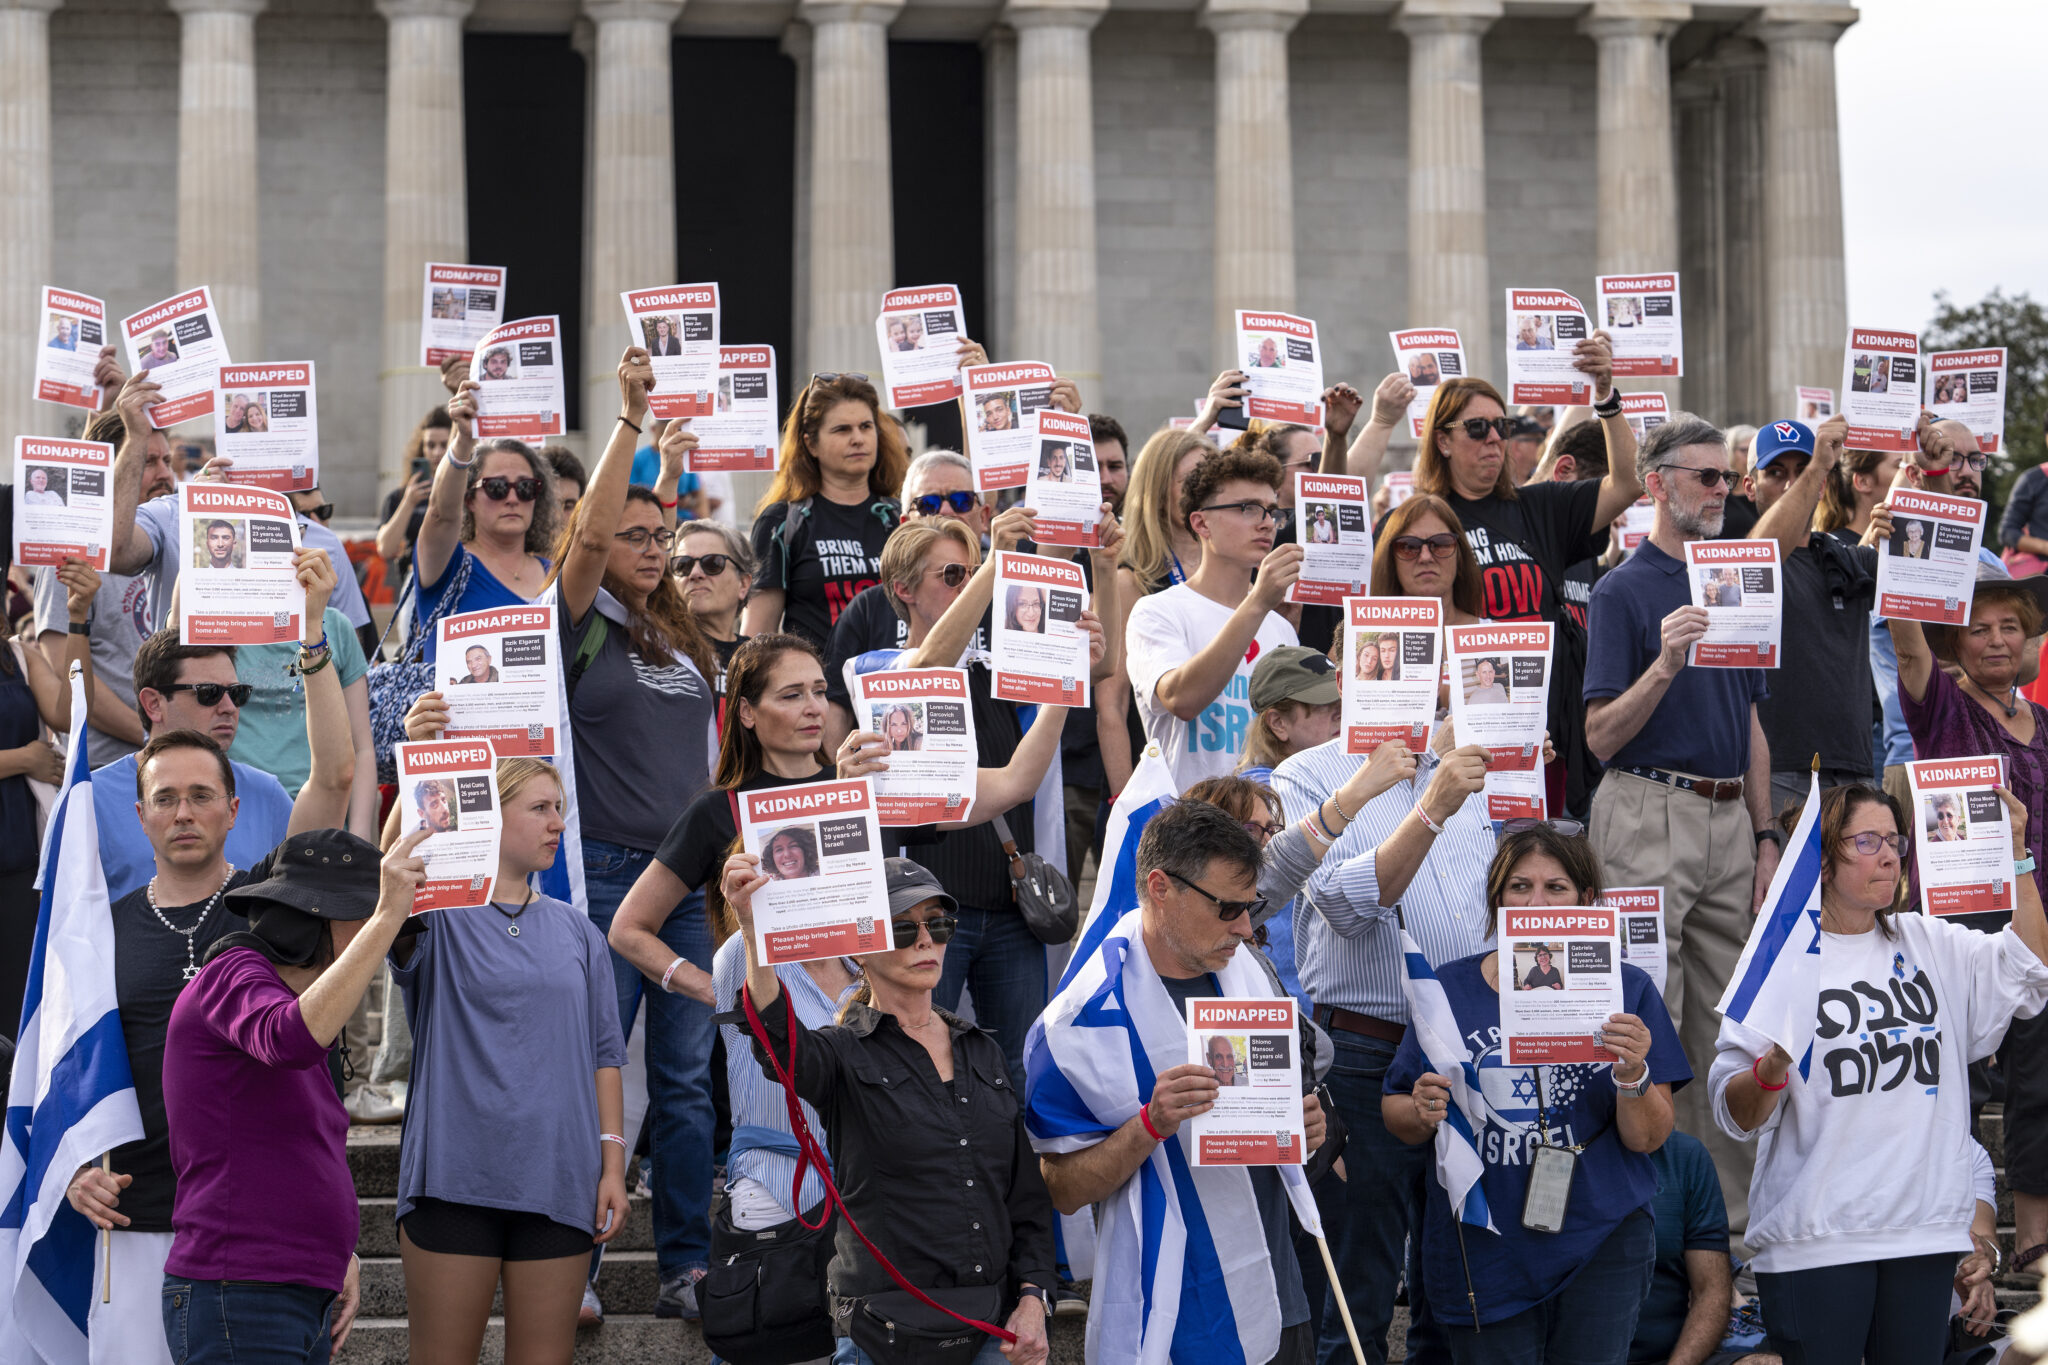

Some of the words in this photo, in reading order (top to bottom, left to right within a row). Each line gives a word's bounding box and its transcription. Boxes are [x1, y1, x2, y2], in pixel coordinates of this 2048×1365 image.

[434, 270, 498, 281] KIDNAPPED
[1606, 280, 1672, 290] KIDNAPPED
[51, 295, 100, 315] KIDNAPPED
[635, 292, 711, 307] KIDNAPPED
[130, 296, 202, 331] KIDNAPPED
[1246, 317, 1309, 333] KIDNAPPED
[1401, 335, 1456, 346] KIDNAPPED
[1856, 334, 1915, 348] KIDNAPPED
[720, 353, 766, 363] APPED
[1936, 355, 1999, 367] KIDNAPPED
[225, 370, 305, 382] KIDNAPPED
[973, 368, 1050, 384] KIDNAPPED
[1622, 399, 1663, 408] DNAPPED
[1043, 418, 1088, 434] KIDNAPPED
[26, 444, 105, 460] KIDNAPPED
[1305, 482, 1361, 495] KIDNAPPED
[193, 493, 285, 511] KIDNAPPED
[1895, 496, 1976, 517] KIDNAPPED
[816, 539, 864, 557] BRING
[1697, 547, 1770, 558] KIDNAPPED
[820, 556, 867, 577] THEM
[1007, 561, 1079, 581] KIDNAPPED
[1357, 607, 1434, 619] KIDNAPPED
[450, 614, 544, 634] KIDNAPPED
[1459, 633, 1545, 646] KIDNAPPED
[869, 678, 960, 692] KIDNAPPED
[408, 749, 486, 766] KIDNAPPED
[1920, 766, 1996, 782] KIDNAPPED
[755, 789, 862, 814] KIDNAPPED
[1512, 917, 1609, 929] KIDNAPPED
[1200, 1009, 1287, 1022] KIDNAPPED
